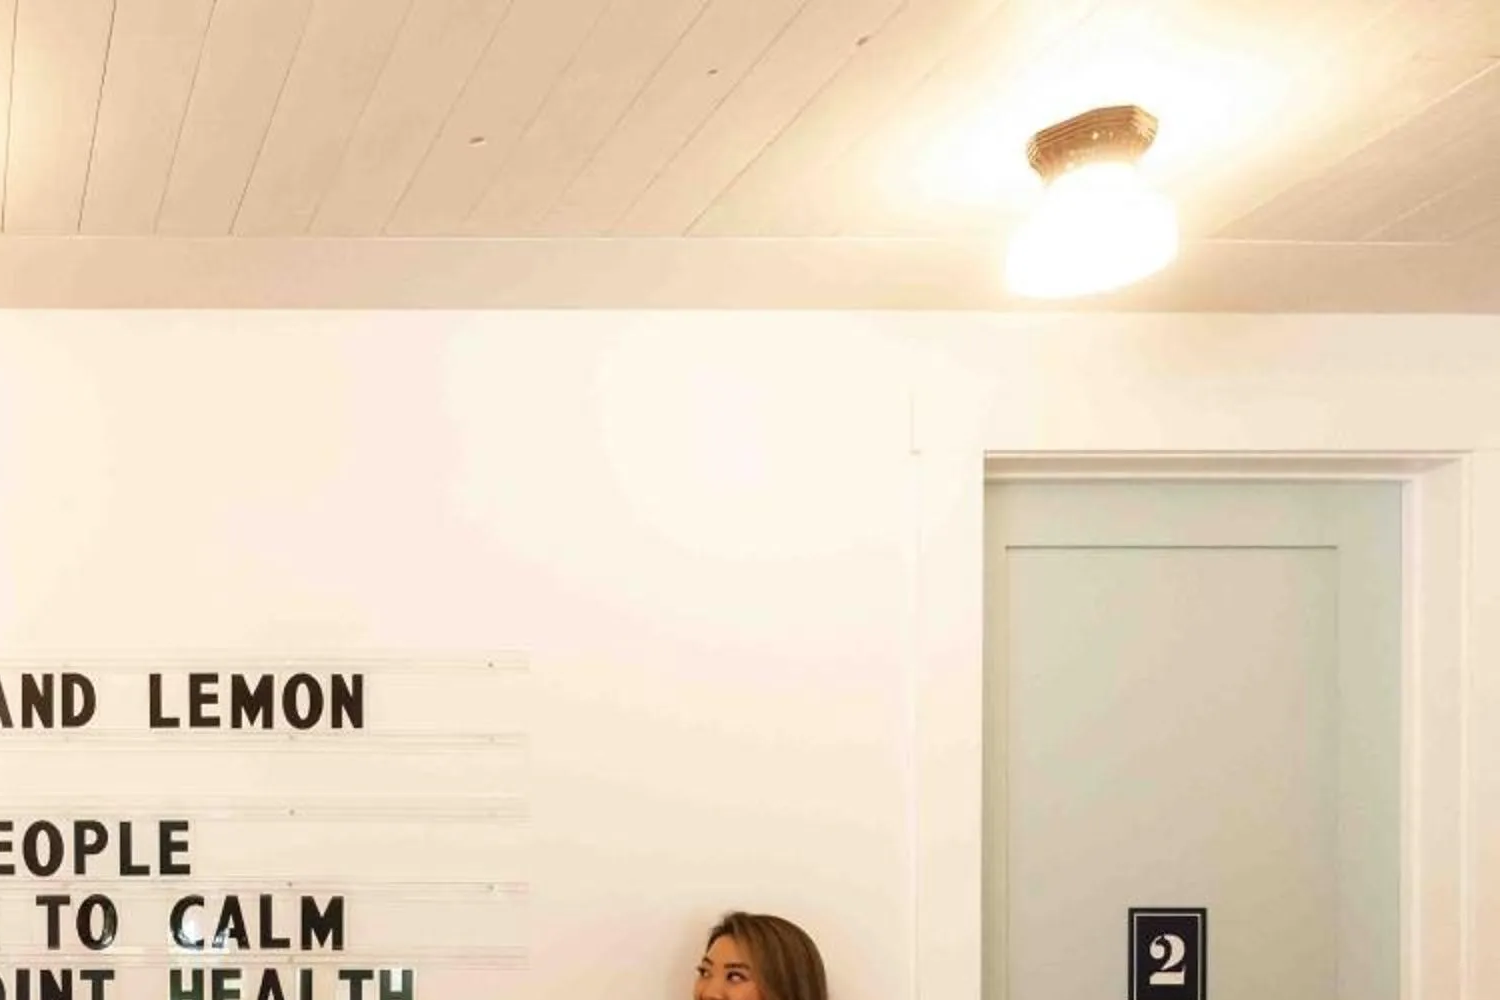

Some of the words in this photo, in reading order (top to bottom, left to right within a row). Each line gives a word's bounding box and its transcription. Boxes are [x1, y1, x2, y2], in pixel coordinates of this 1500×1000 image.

[148, 672, 366, 730] LEMON
[36, 894, 120, 951] TO
[168, 894, 346, 951] CALM
[1149, 933, 1186, 985] 2
